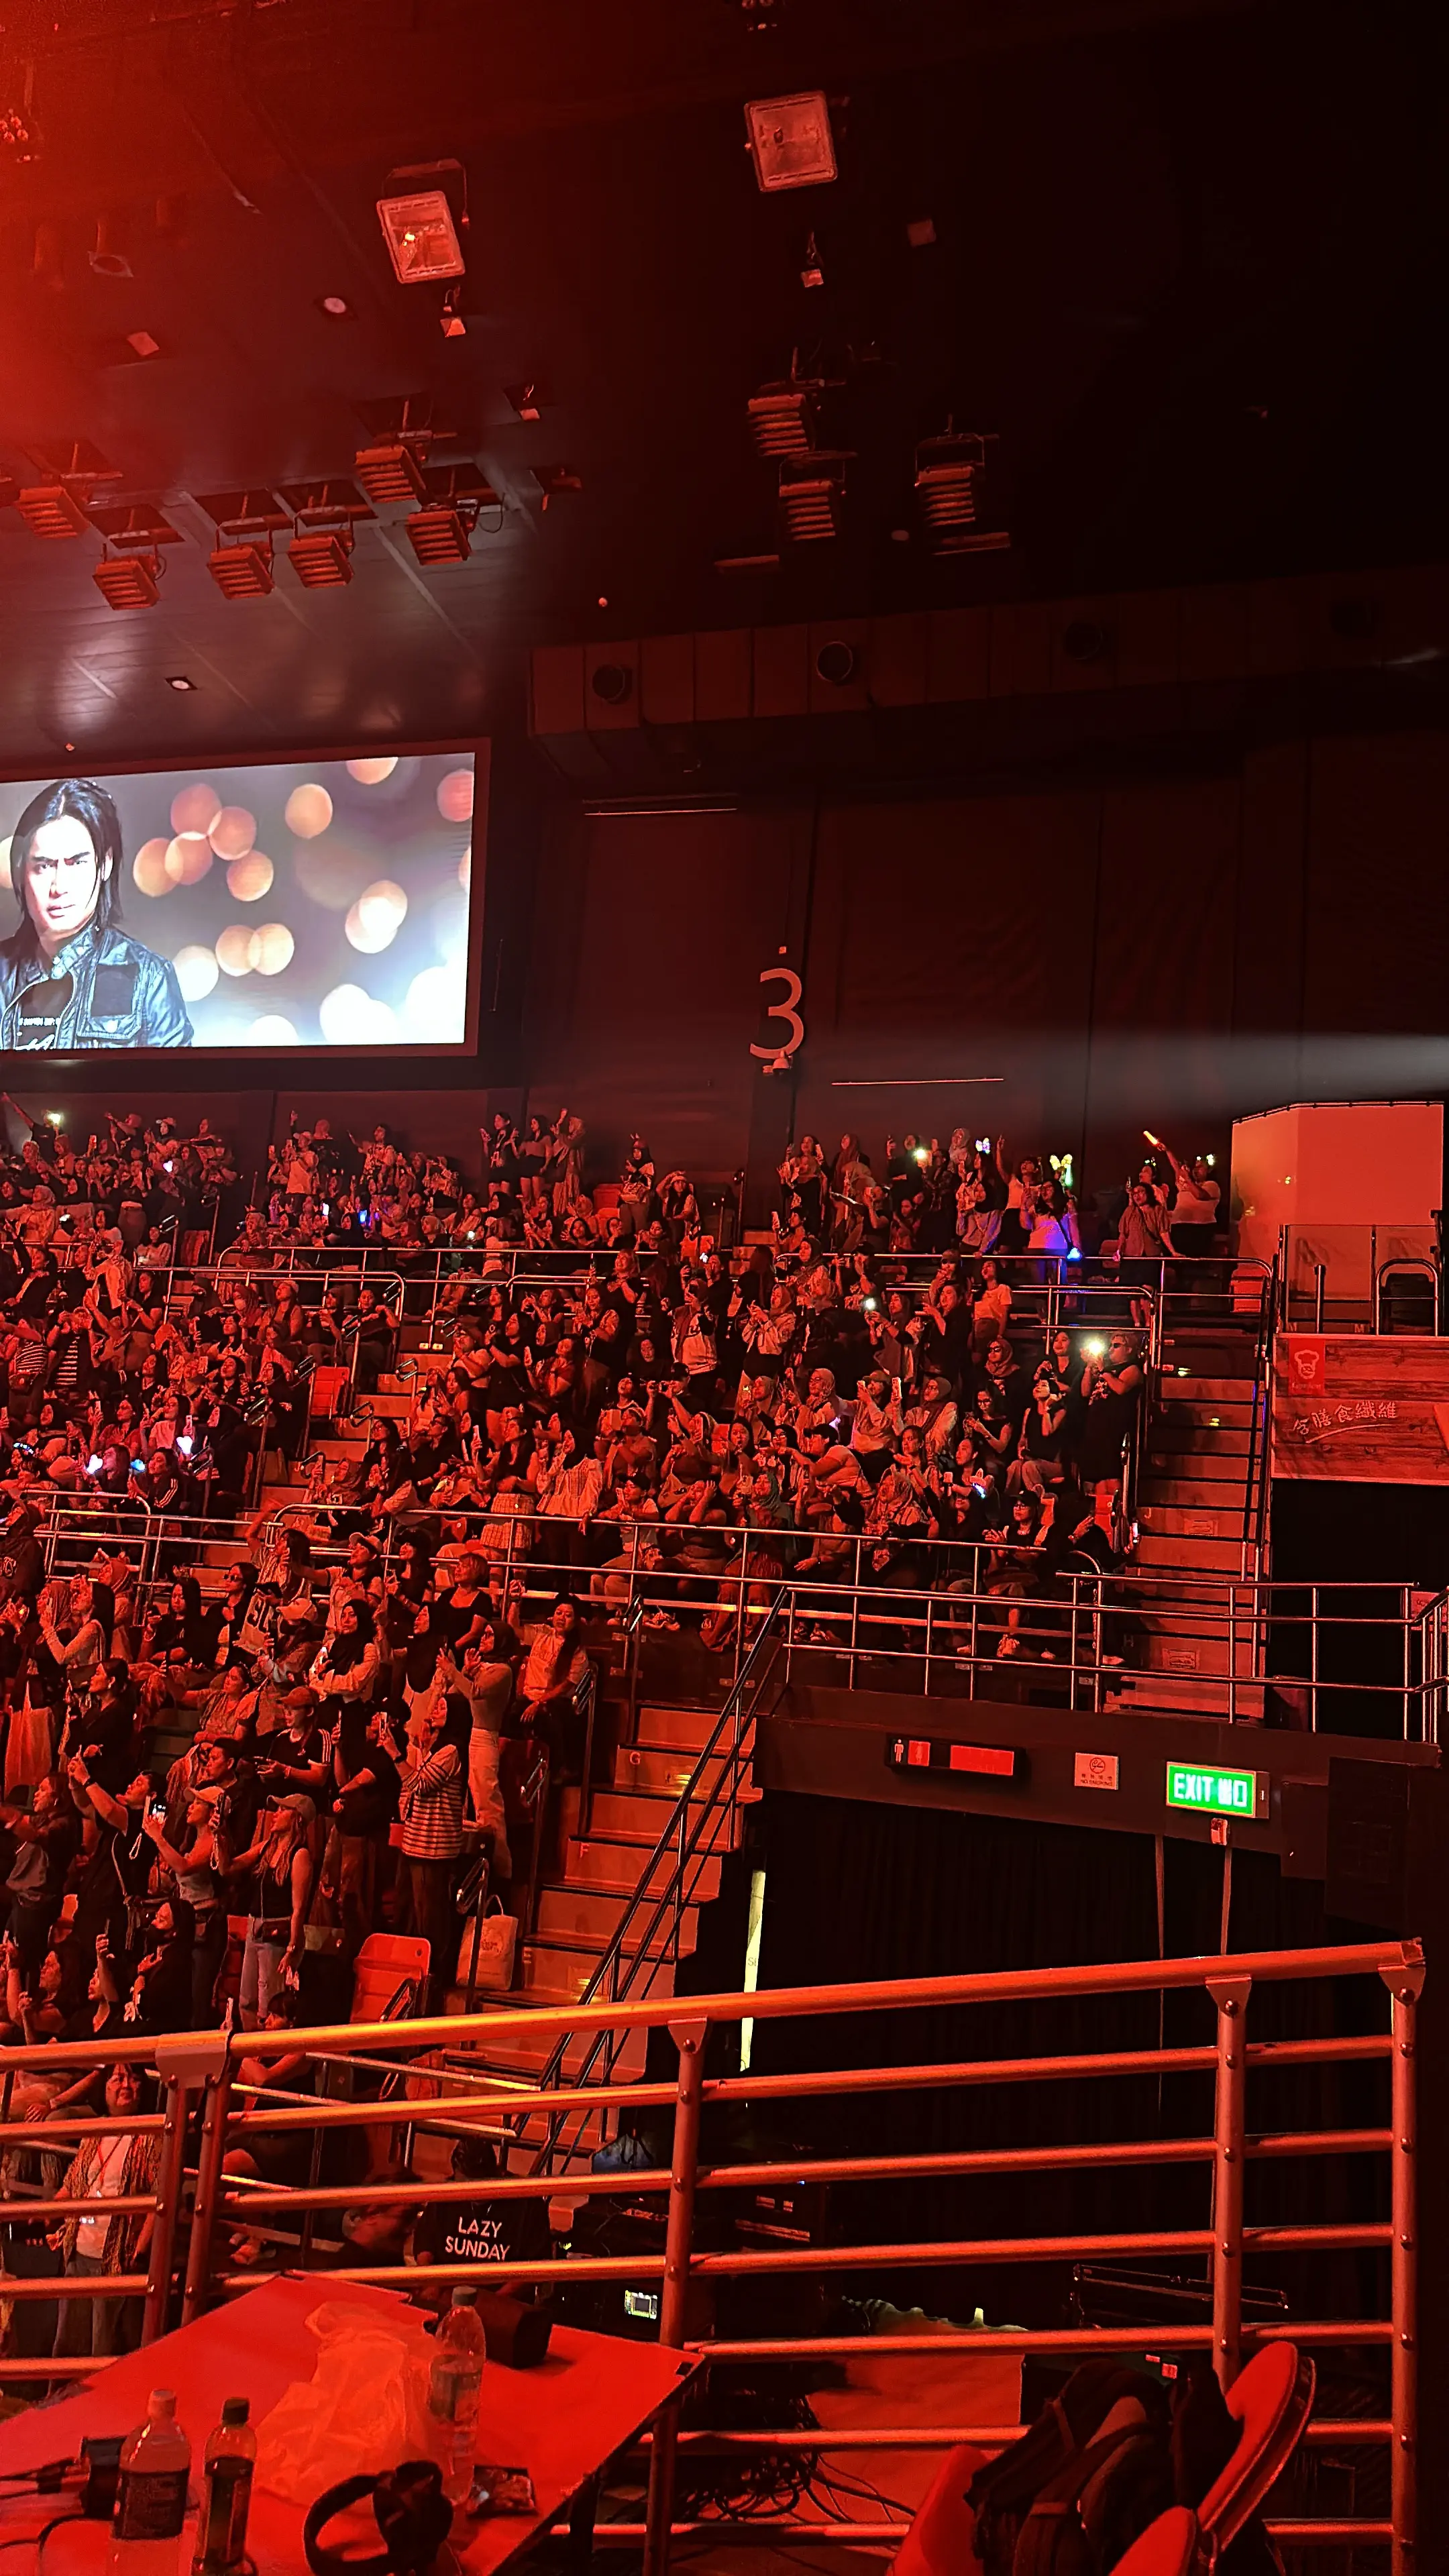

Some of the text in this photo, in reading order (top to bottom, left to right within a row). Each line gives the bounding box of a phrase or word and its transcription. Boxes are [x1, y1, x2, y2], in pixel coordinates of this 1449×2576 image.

[749, 967, 804, 1059] 3
[629, 1751, 641, 1765] G
[1173, 1772, 1215, 1803] EXIT
[580, 1843, 590, 1858] F
[458, 2216, 502, 2239] LAZY
[445, 2235, 511, 2261] SUNDAY
